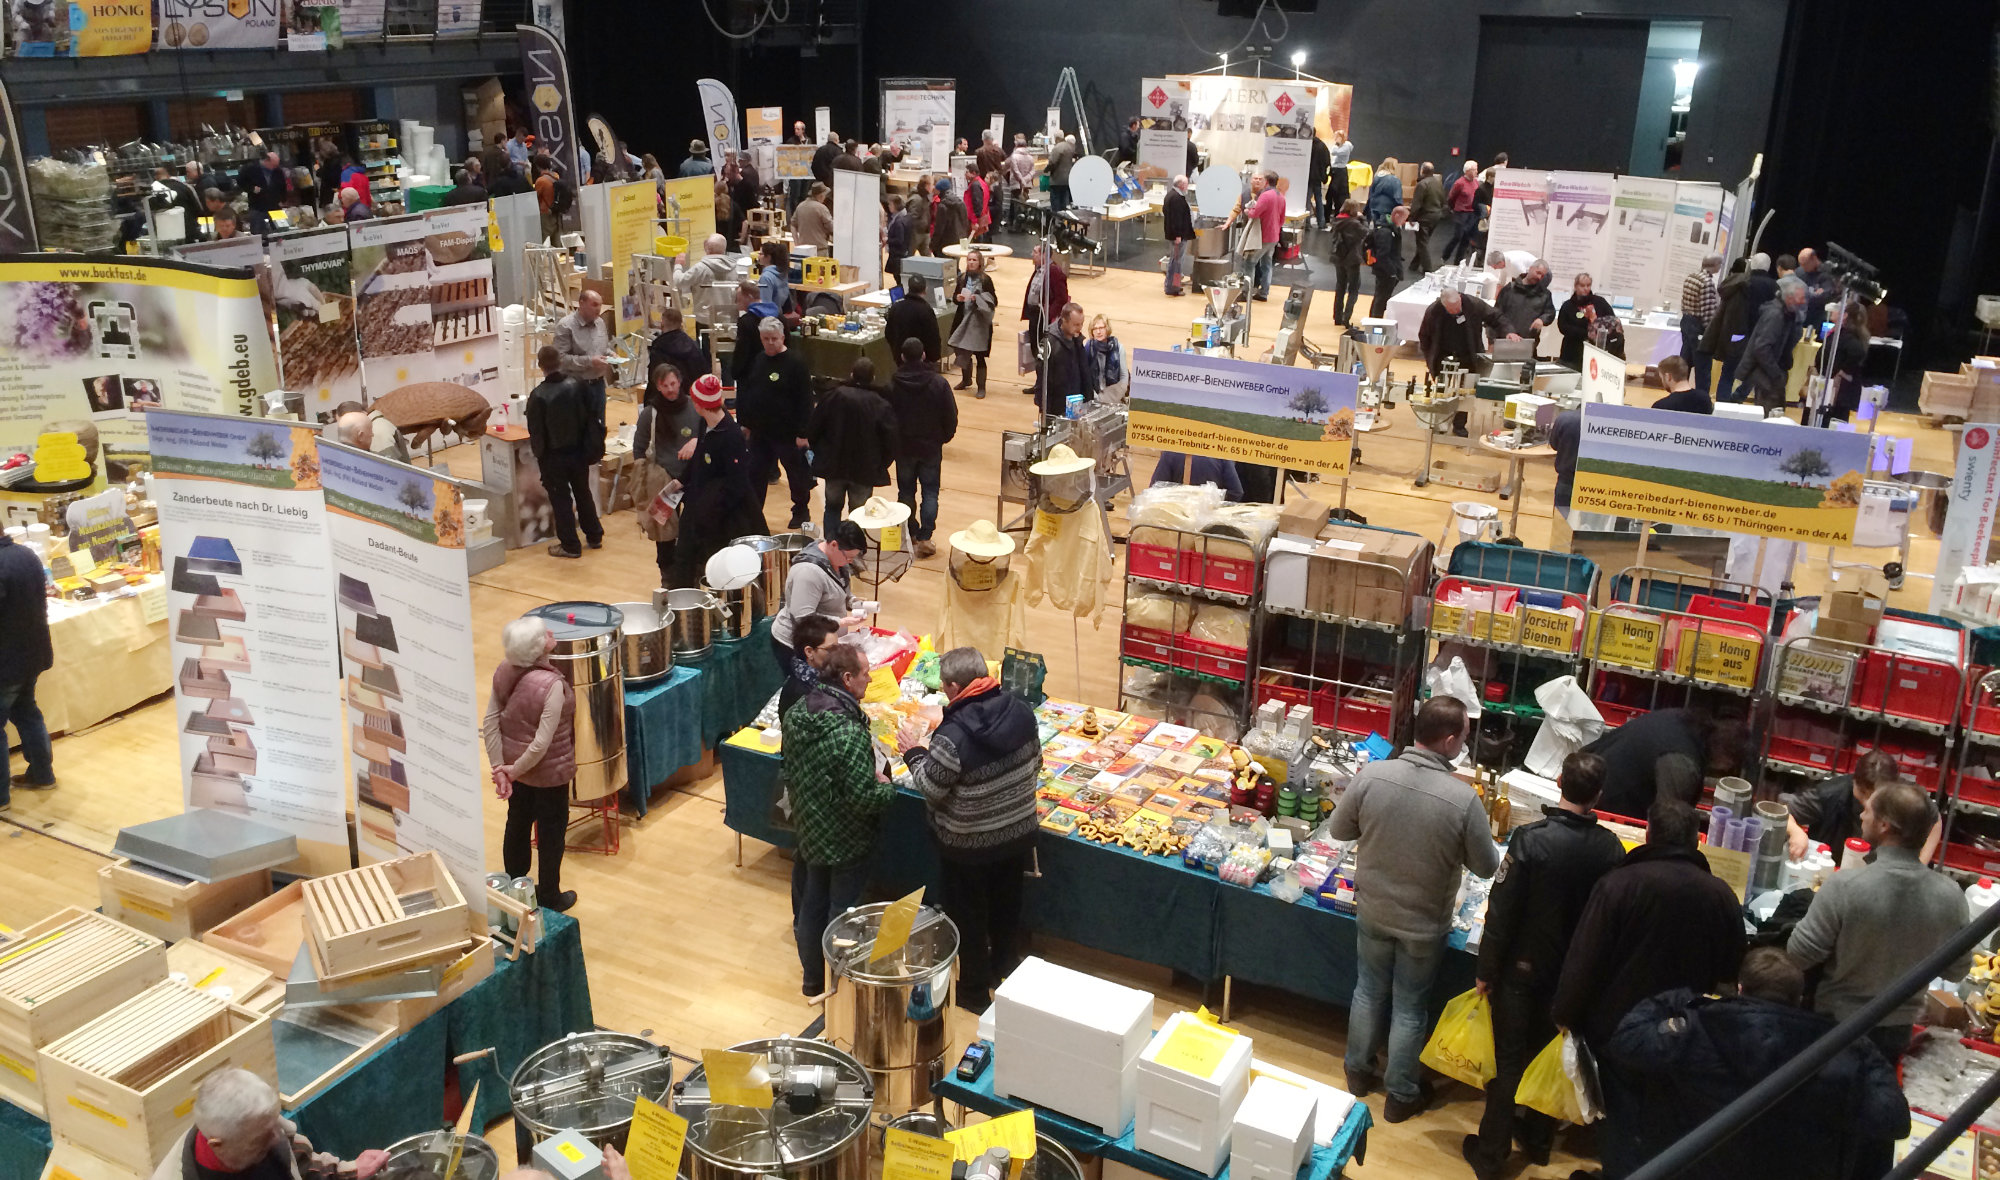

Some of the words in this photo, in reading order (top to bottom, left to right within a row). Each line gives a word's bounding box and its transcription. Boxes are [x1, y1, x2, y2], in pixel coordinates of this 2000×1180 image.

[93, 5, 144, 17] HONIG
[245, 19, 276, 28] POLAND
[59, 267, 147, 281] www.buckfast.de
[1265, 384, 1290, 396] GmbH
[1132, 423, 1289, 450] www.imkereibedarf-bienenweber.de
[1131, 432, 1155, 443] 07554
[1156, 436, 1210, 450] Gera-Trebnitz
[1217, 444, 1229, 453] Nr.
[1230, 446, 1241, 454] 65
[1242, 447, 1248, 456] b
[1254, 449, 1297, 464] Thüringen
[1303, 458, 1314, 466] an
[1316, 458, 1331, 468] der
[1332, 461, 1344, 470] A4
[1751, 443, 1783, 457] GmbH
[1958, 456, 1977, 501] swienty
[173, 492, 234, 508] Zanderbeute
[236, 501, 259, 512] nach
[262, 503, 275, 513] Dr.
[278, 505, 308, 519] Liebig
[1579, 485, 1777, 519] www.imkereibedarf-bienenweber.de
[1981, 497, 1993, 513] for
[1577, 495, 1607, 506] 07554
[1609, 499, 1677, 518] Gera-Trebnitz
[1685, 511, 1700, 521] Nr.
[1702, 513, 1715, 523] 65
[1717, 515, 1724, 524] b
[1733, 517, 1787, 534] Thüringen
[1796, 528, 1809, 536] an
[1811, 528, 1830, 539] der
[1832, 532, 1848, 541] A4
[368, 538, 418, 563] Dadant-Beute
[1523, 612, 1569, 632] Vorsicht
[1523, 628, 1562, 647] Bienen
[1622, 622, 1654, 643] Honig
[1720, 641, 1751, 661] Honig
[1722, 658, 1743, 670] aus
[1788, 653, 1845, 675] HONIG
[1718, 670, 1747, 682] Imkerei
